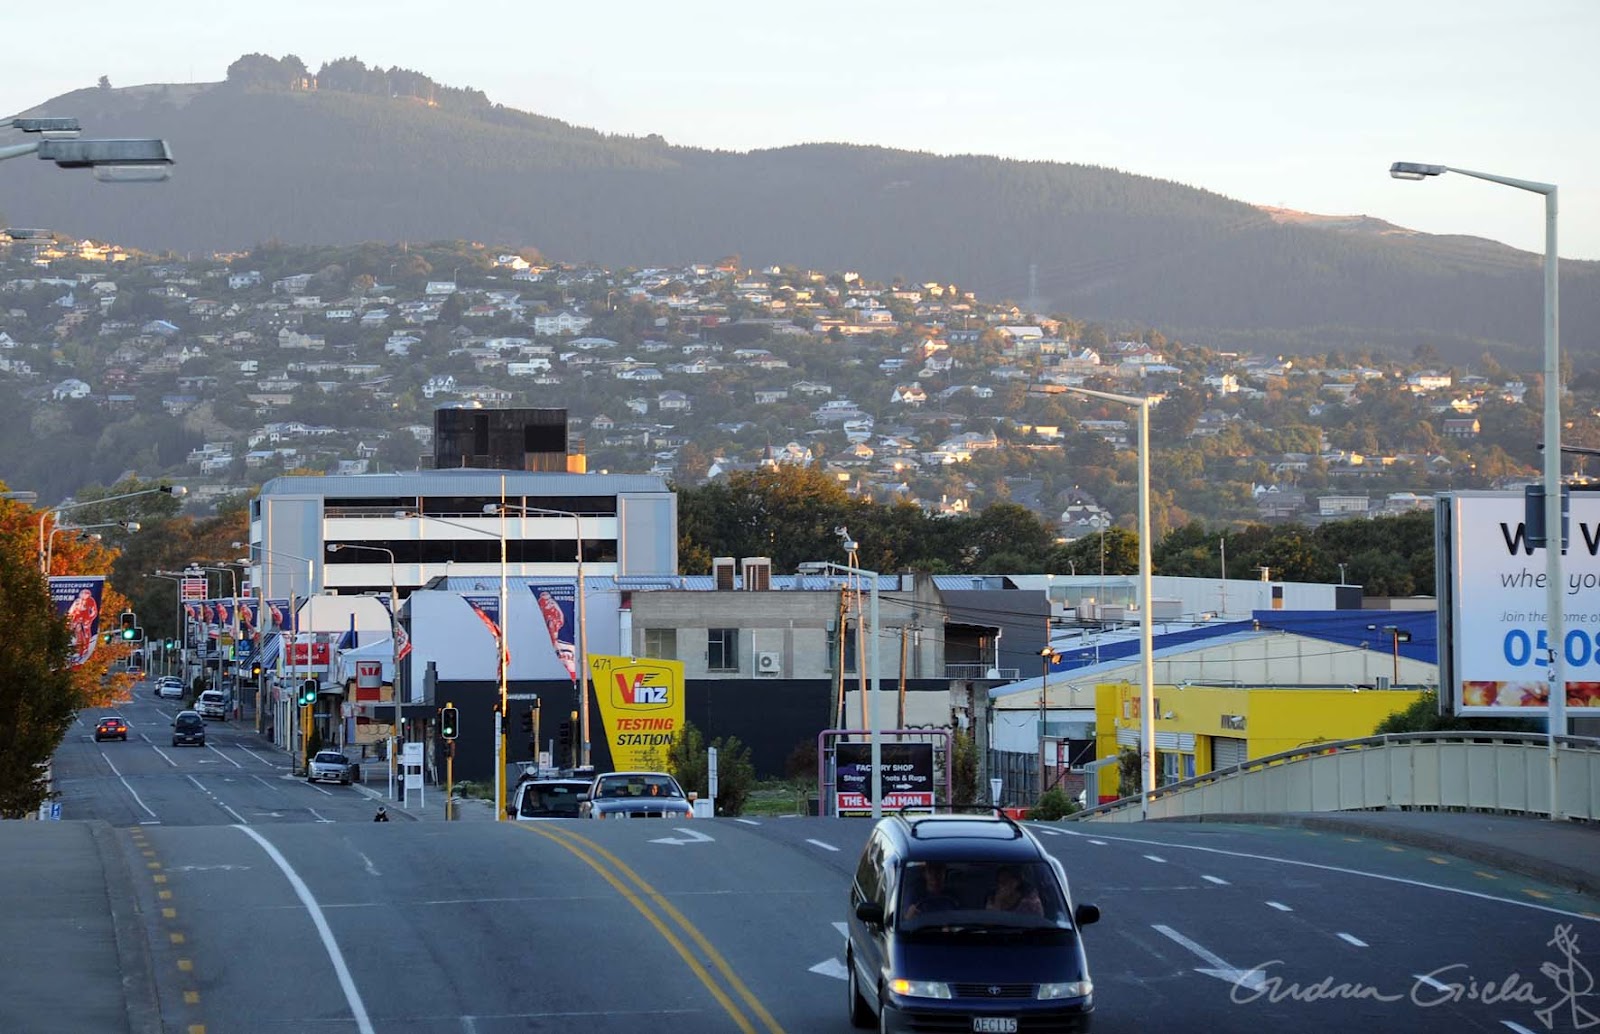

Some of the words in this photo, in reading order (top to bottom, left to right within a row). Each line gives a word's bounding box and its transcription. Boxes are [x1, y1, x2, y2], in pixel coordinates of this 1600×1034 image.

[1501, 568, 1547, 588] whe
[1567, 573, 1600, 595] yo
[1500, 611, 1525, 622] Join
[1529, 611, 1548, 622] the
[1503, 629, 1600, 667] 050
[296, 652, 319, 660] Schol
[592, 658, 612, 671] 471
[615, 673, 668, 704] Vinz
[616, 718, 674, 731] TESTING
[616, 733, 674, 746] STATION
[855, 764, 892, 772] FACRY
[892, 764, 914, 772] SHOP
[882, 774, 900, 782] oots
[908, 774, 926, 783] Rugs
[842, 796, 862, 806] THE
[897, 796, 922, 806] MAN
[974, 1019, 1016, 1032] AEC115
